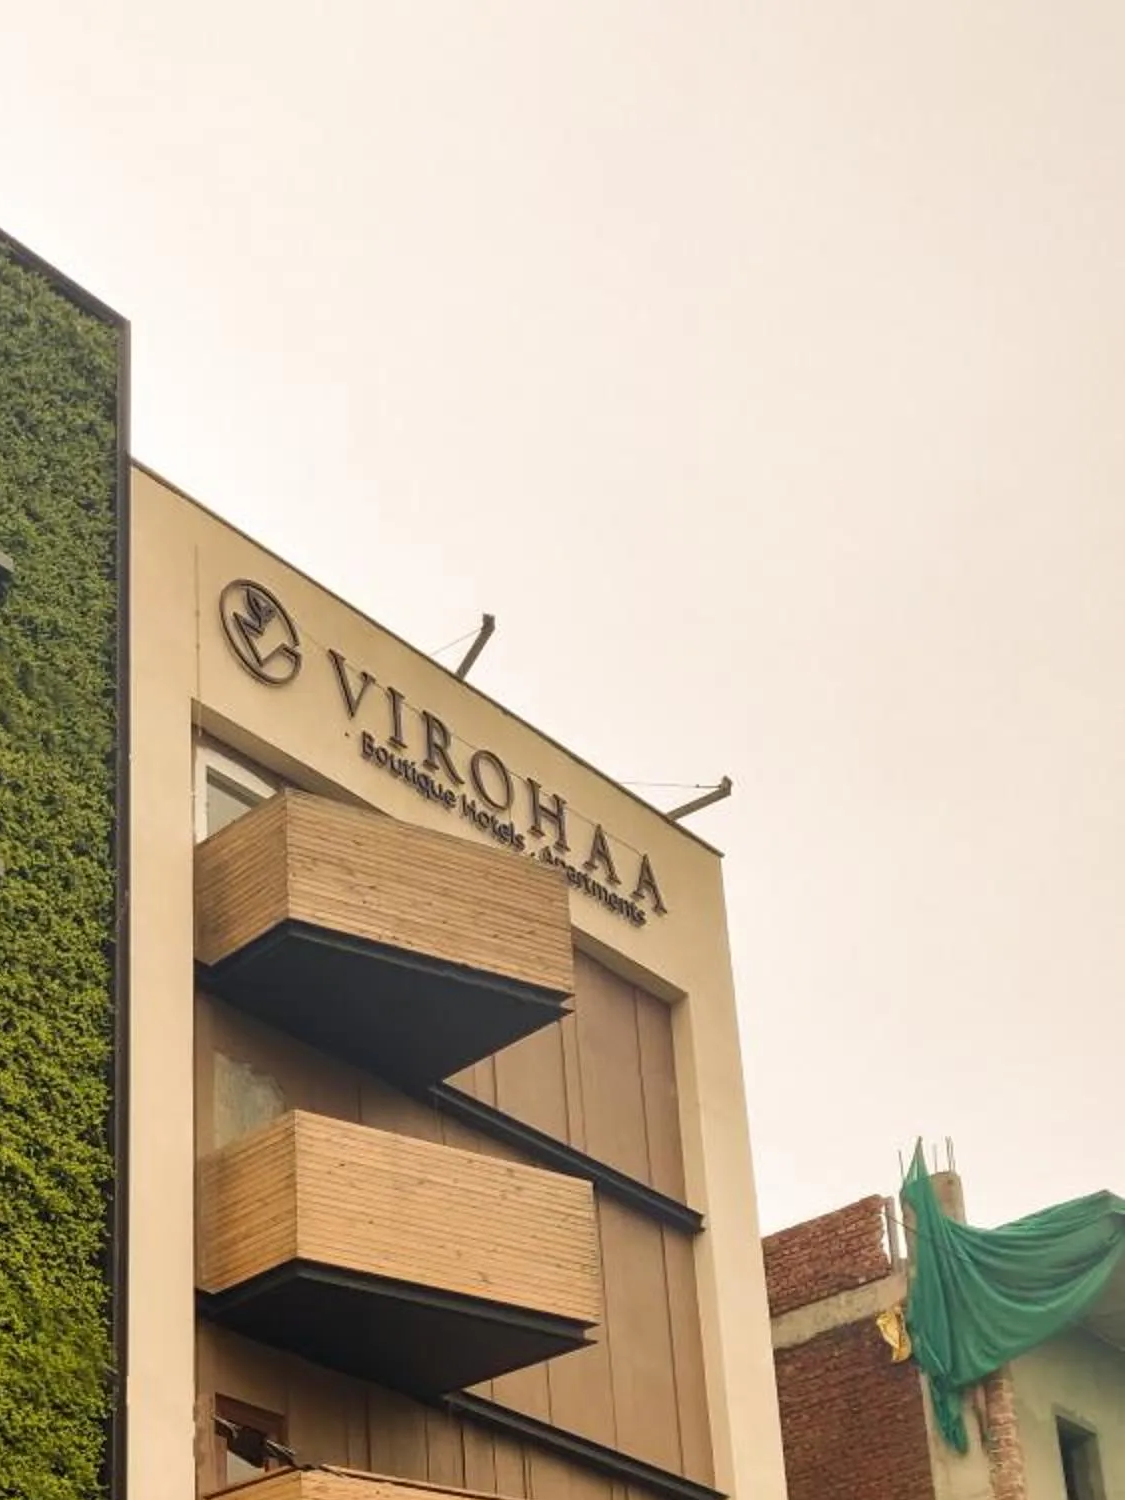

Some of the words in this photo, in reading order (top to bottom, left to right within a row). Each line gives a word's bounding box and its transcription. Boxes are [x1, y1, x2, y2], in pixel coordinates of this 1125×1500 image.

[329, 647, 669, 917] VIROHAA
[360, 729, 457, 811] Boutique
[459, 793, 526, 853] Hotels
